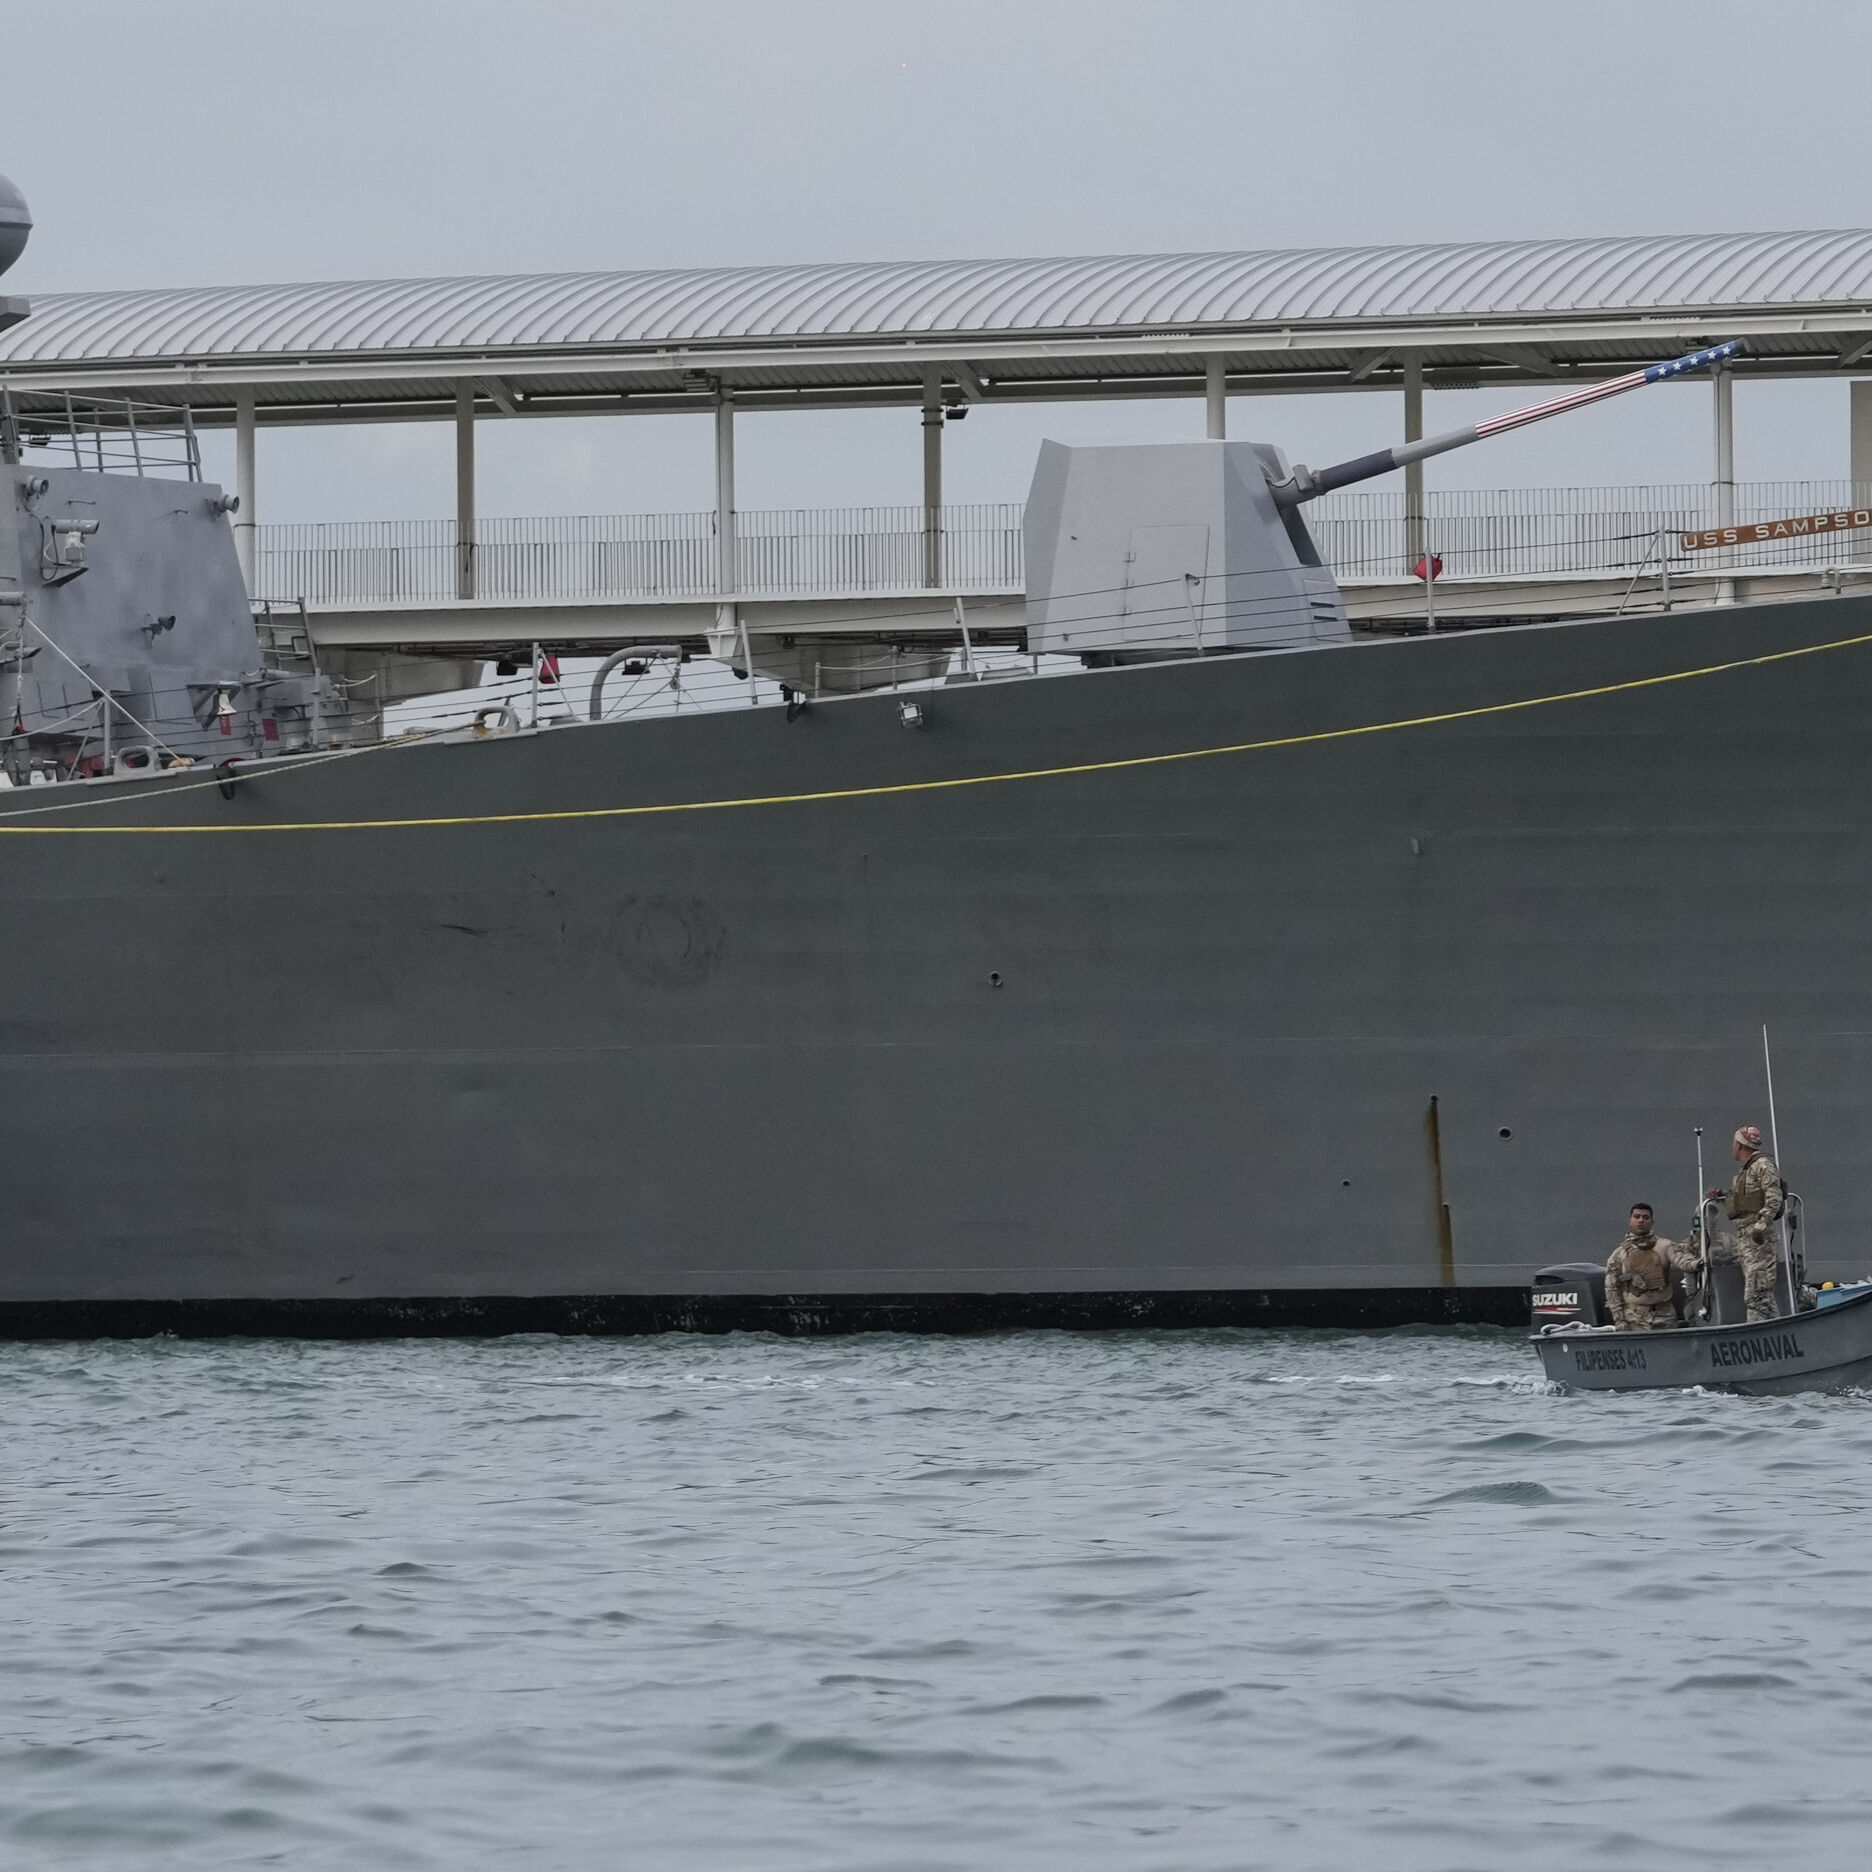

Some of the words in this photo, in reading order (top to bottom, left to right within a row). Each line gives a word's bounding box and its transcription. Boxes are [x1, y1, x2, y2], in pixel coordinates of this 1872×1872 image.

[1683, 528, 1738, 549] USS
[1532, 1292, 1579, 1307] SUZUKI
[1575, 1349, 1627, 1371] FILIPENSES
[1711, 1334, 1805, 1368] AERONAVAL
